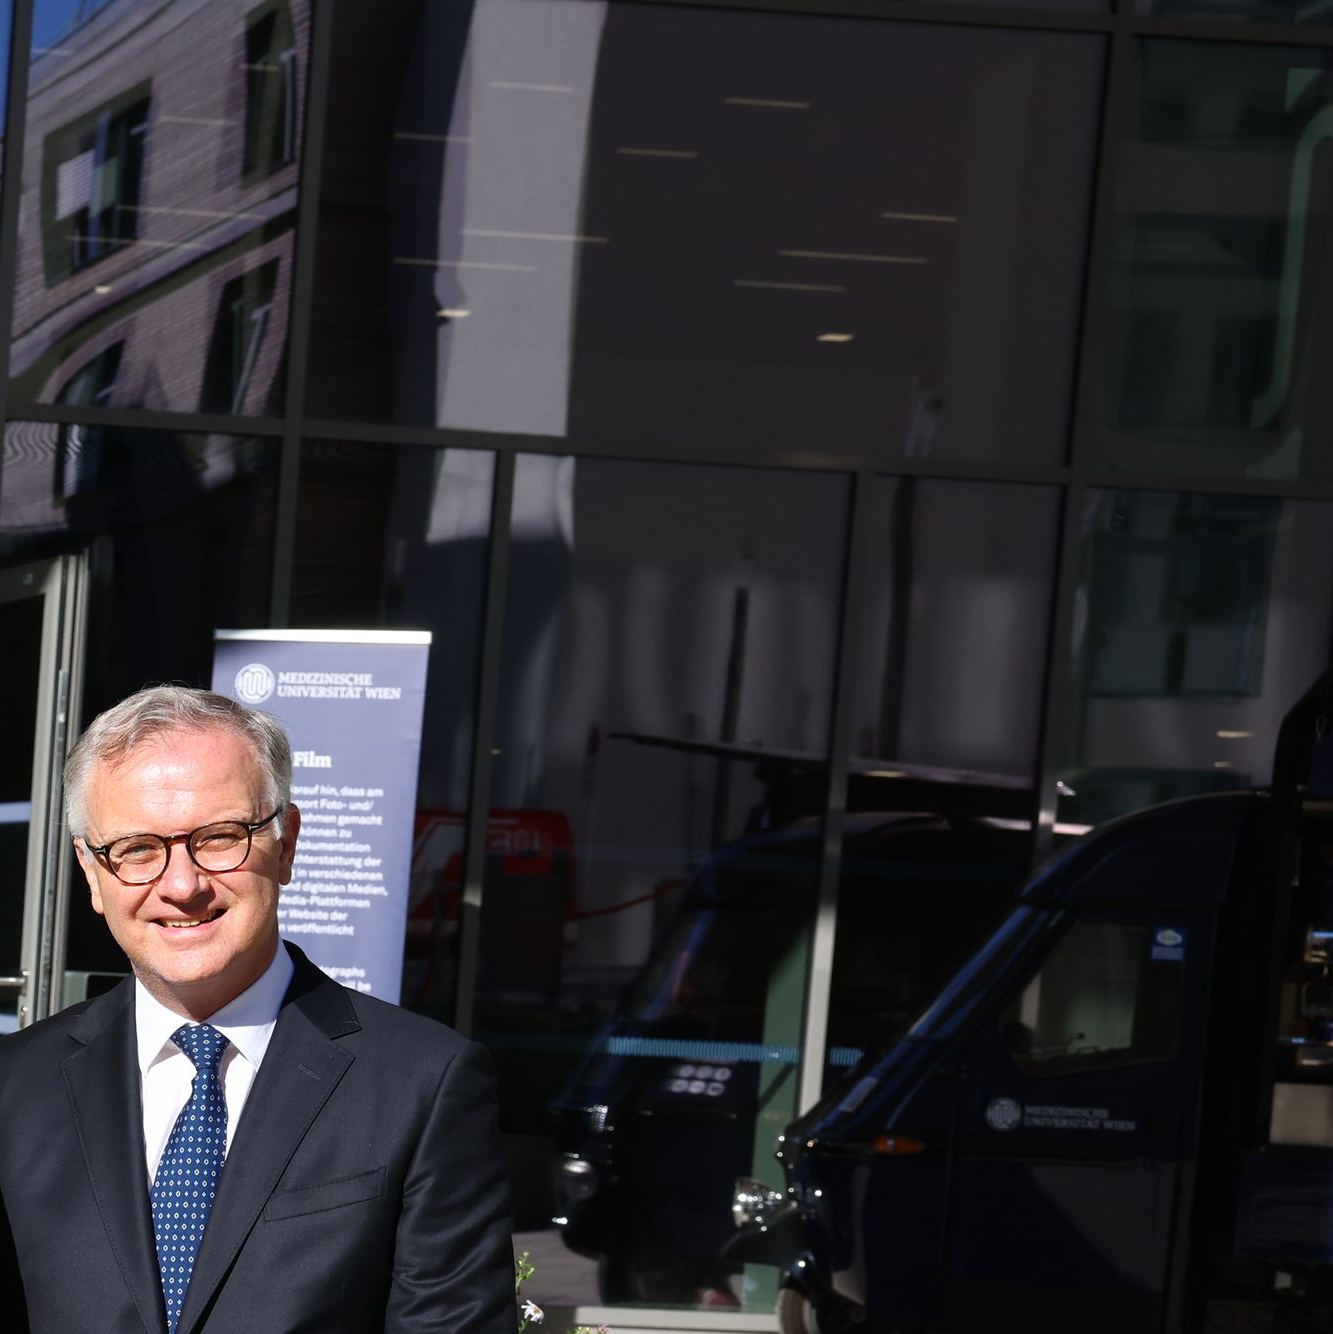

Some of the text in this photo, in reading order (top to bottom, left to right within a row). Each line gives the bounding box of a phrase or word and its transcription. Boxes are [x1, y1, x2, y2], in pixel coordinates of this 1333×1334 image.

[278, 672, 373, 686] MEDIZINISCHE
[277, 684, 402, 700] UNIVERSITÄT WIEN
[293, 750, 332, 768] Film
[340, 785, 365, 797] dass
[366, 788, 384, 797] am
[337, 815, 383, 826] gemacht
[338, 829, 352, 838] zu
[363, 856, 382, 867] der
[308, 869, 383, 881] verschiedenen
[301, 881, 346, 894] digitalen
[347, 883, 389, 896] Medien,
[288, 908, 329, 920] Website
[329, 910, 348, 921] der
[287, 922, 354, 936] veröffentlicht
